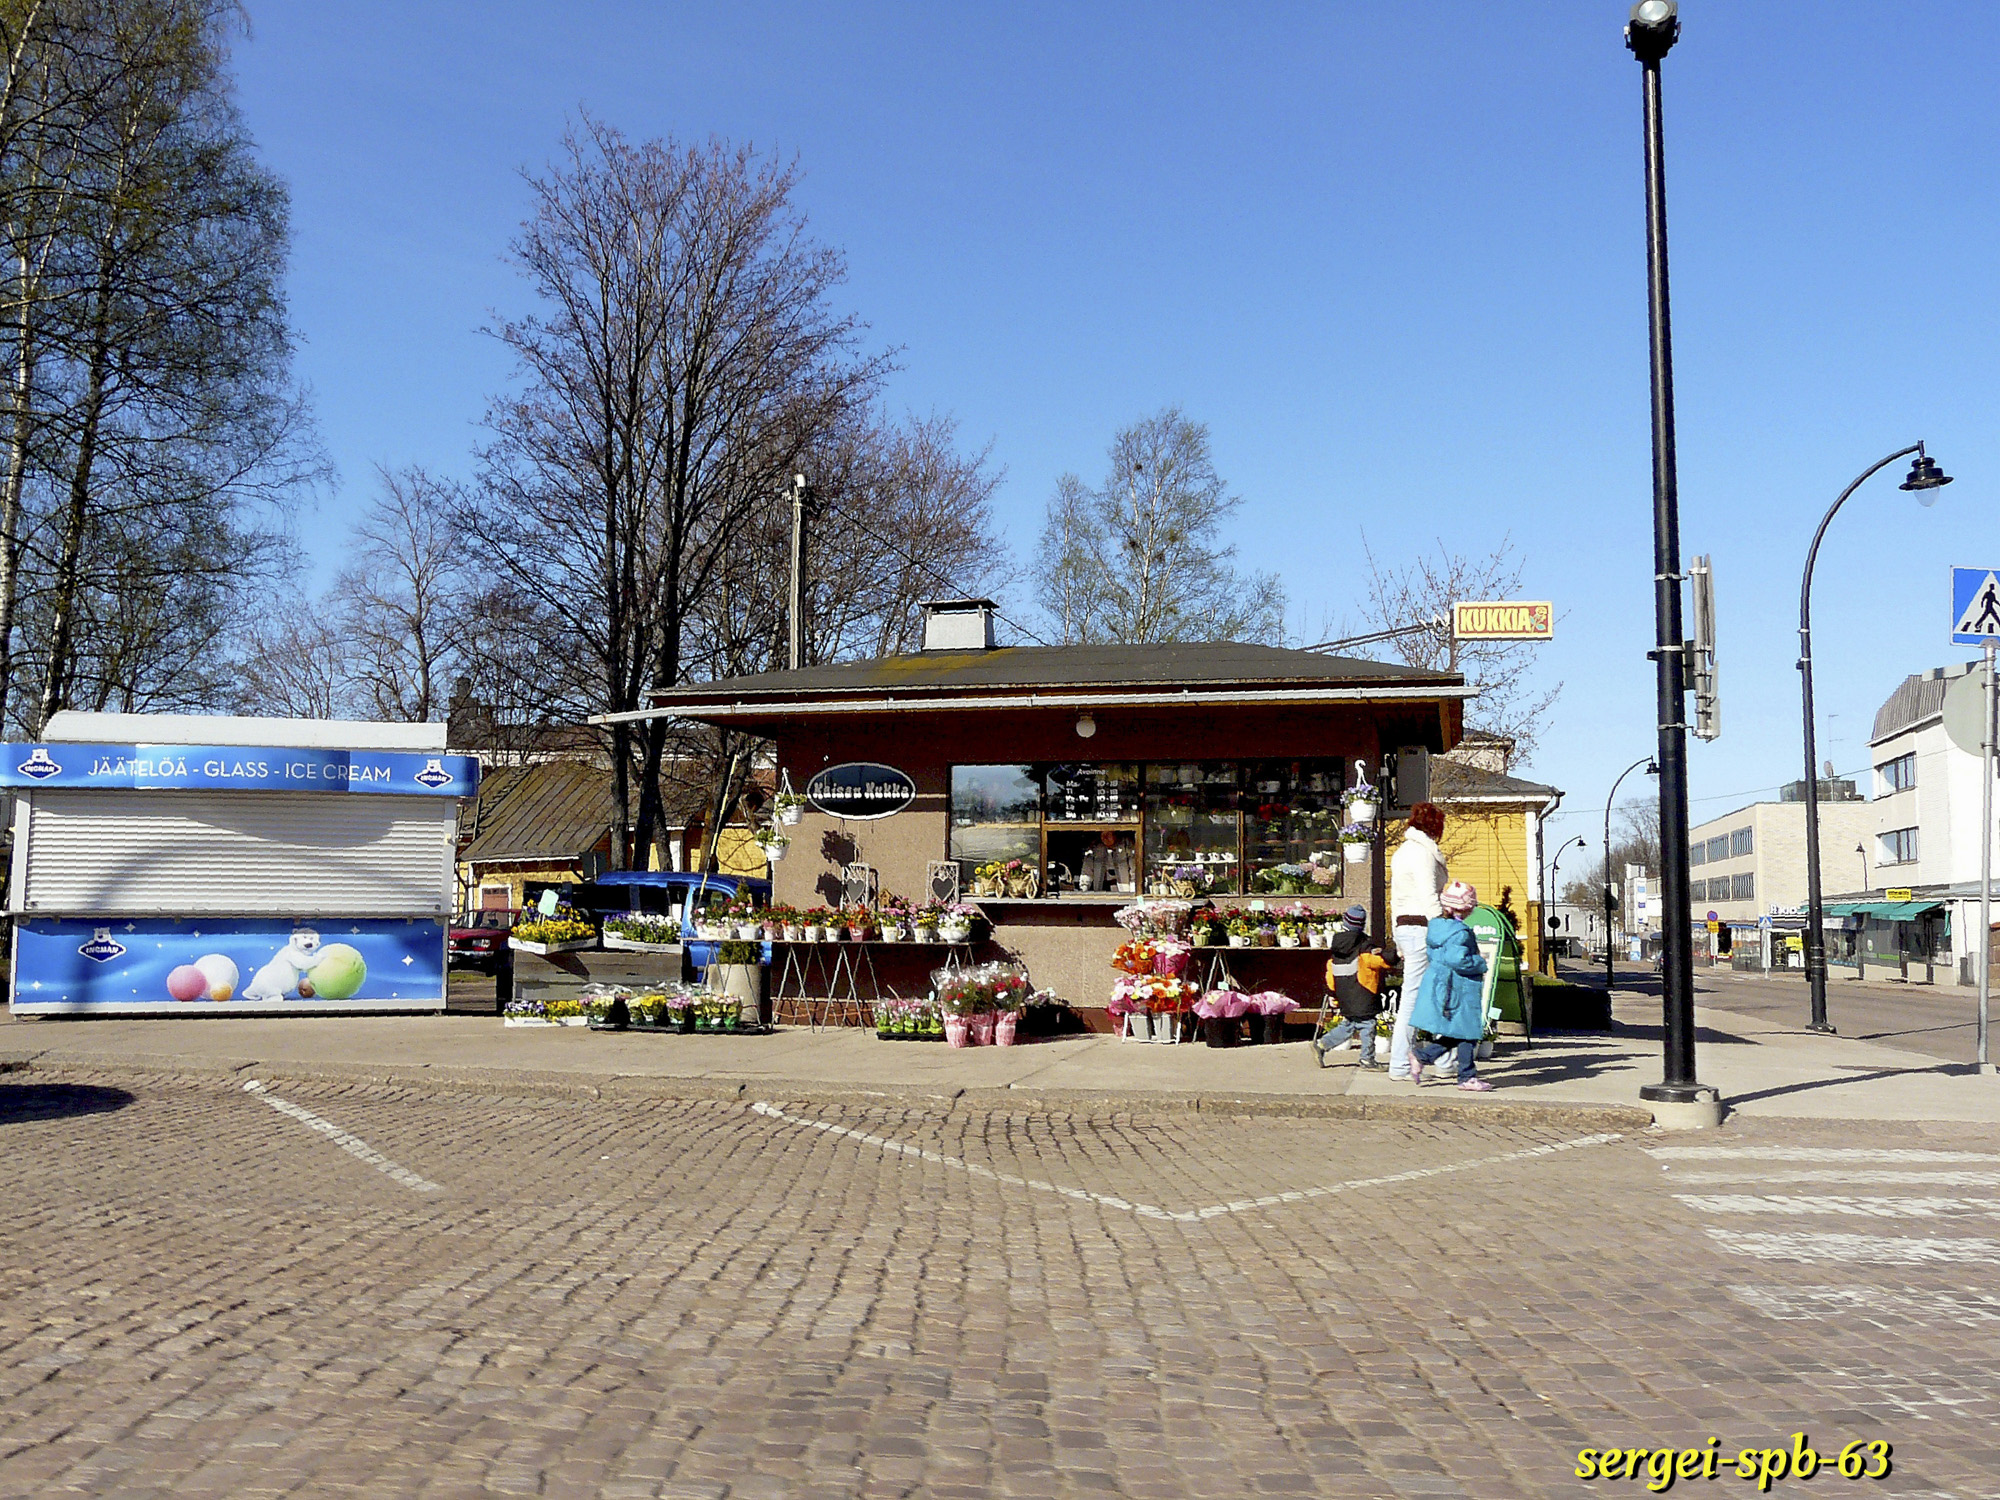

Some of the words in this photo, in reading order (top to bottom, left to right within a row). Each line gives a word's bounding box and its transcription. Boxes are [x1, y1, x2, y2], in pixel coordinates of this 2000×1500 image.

[1460, 607, 1532, 632] KUKKIA
[88, 756, 188, 777] JÄÄTELÖÄ
[203, 760, 269, 778] GLASS
[285, 762, 317, 780] ICE
[322, 764, 392, 783] CREAM
[812, 781, 863, 799] Kaisan
[864, 781, 910, 800] Kukka
[85, 945, 119, 954] INGMAN
